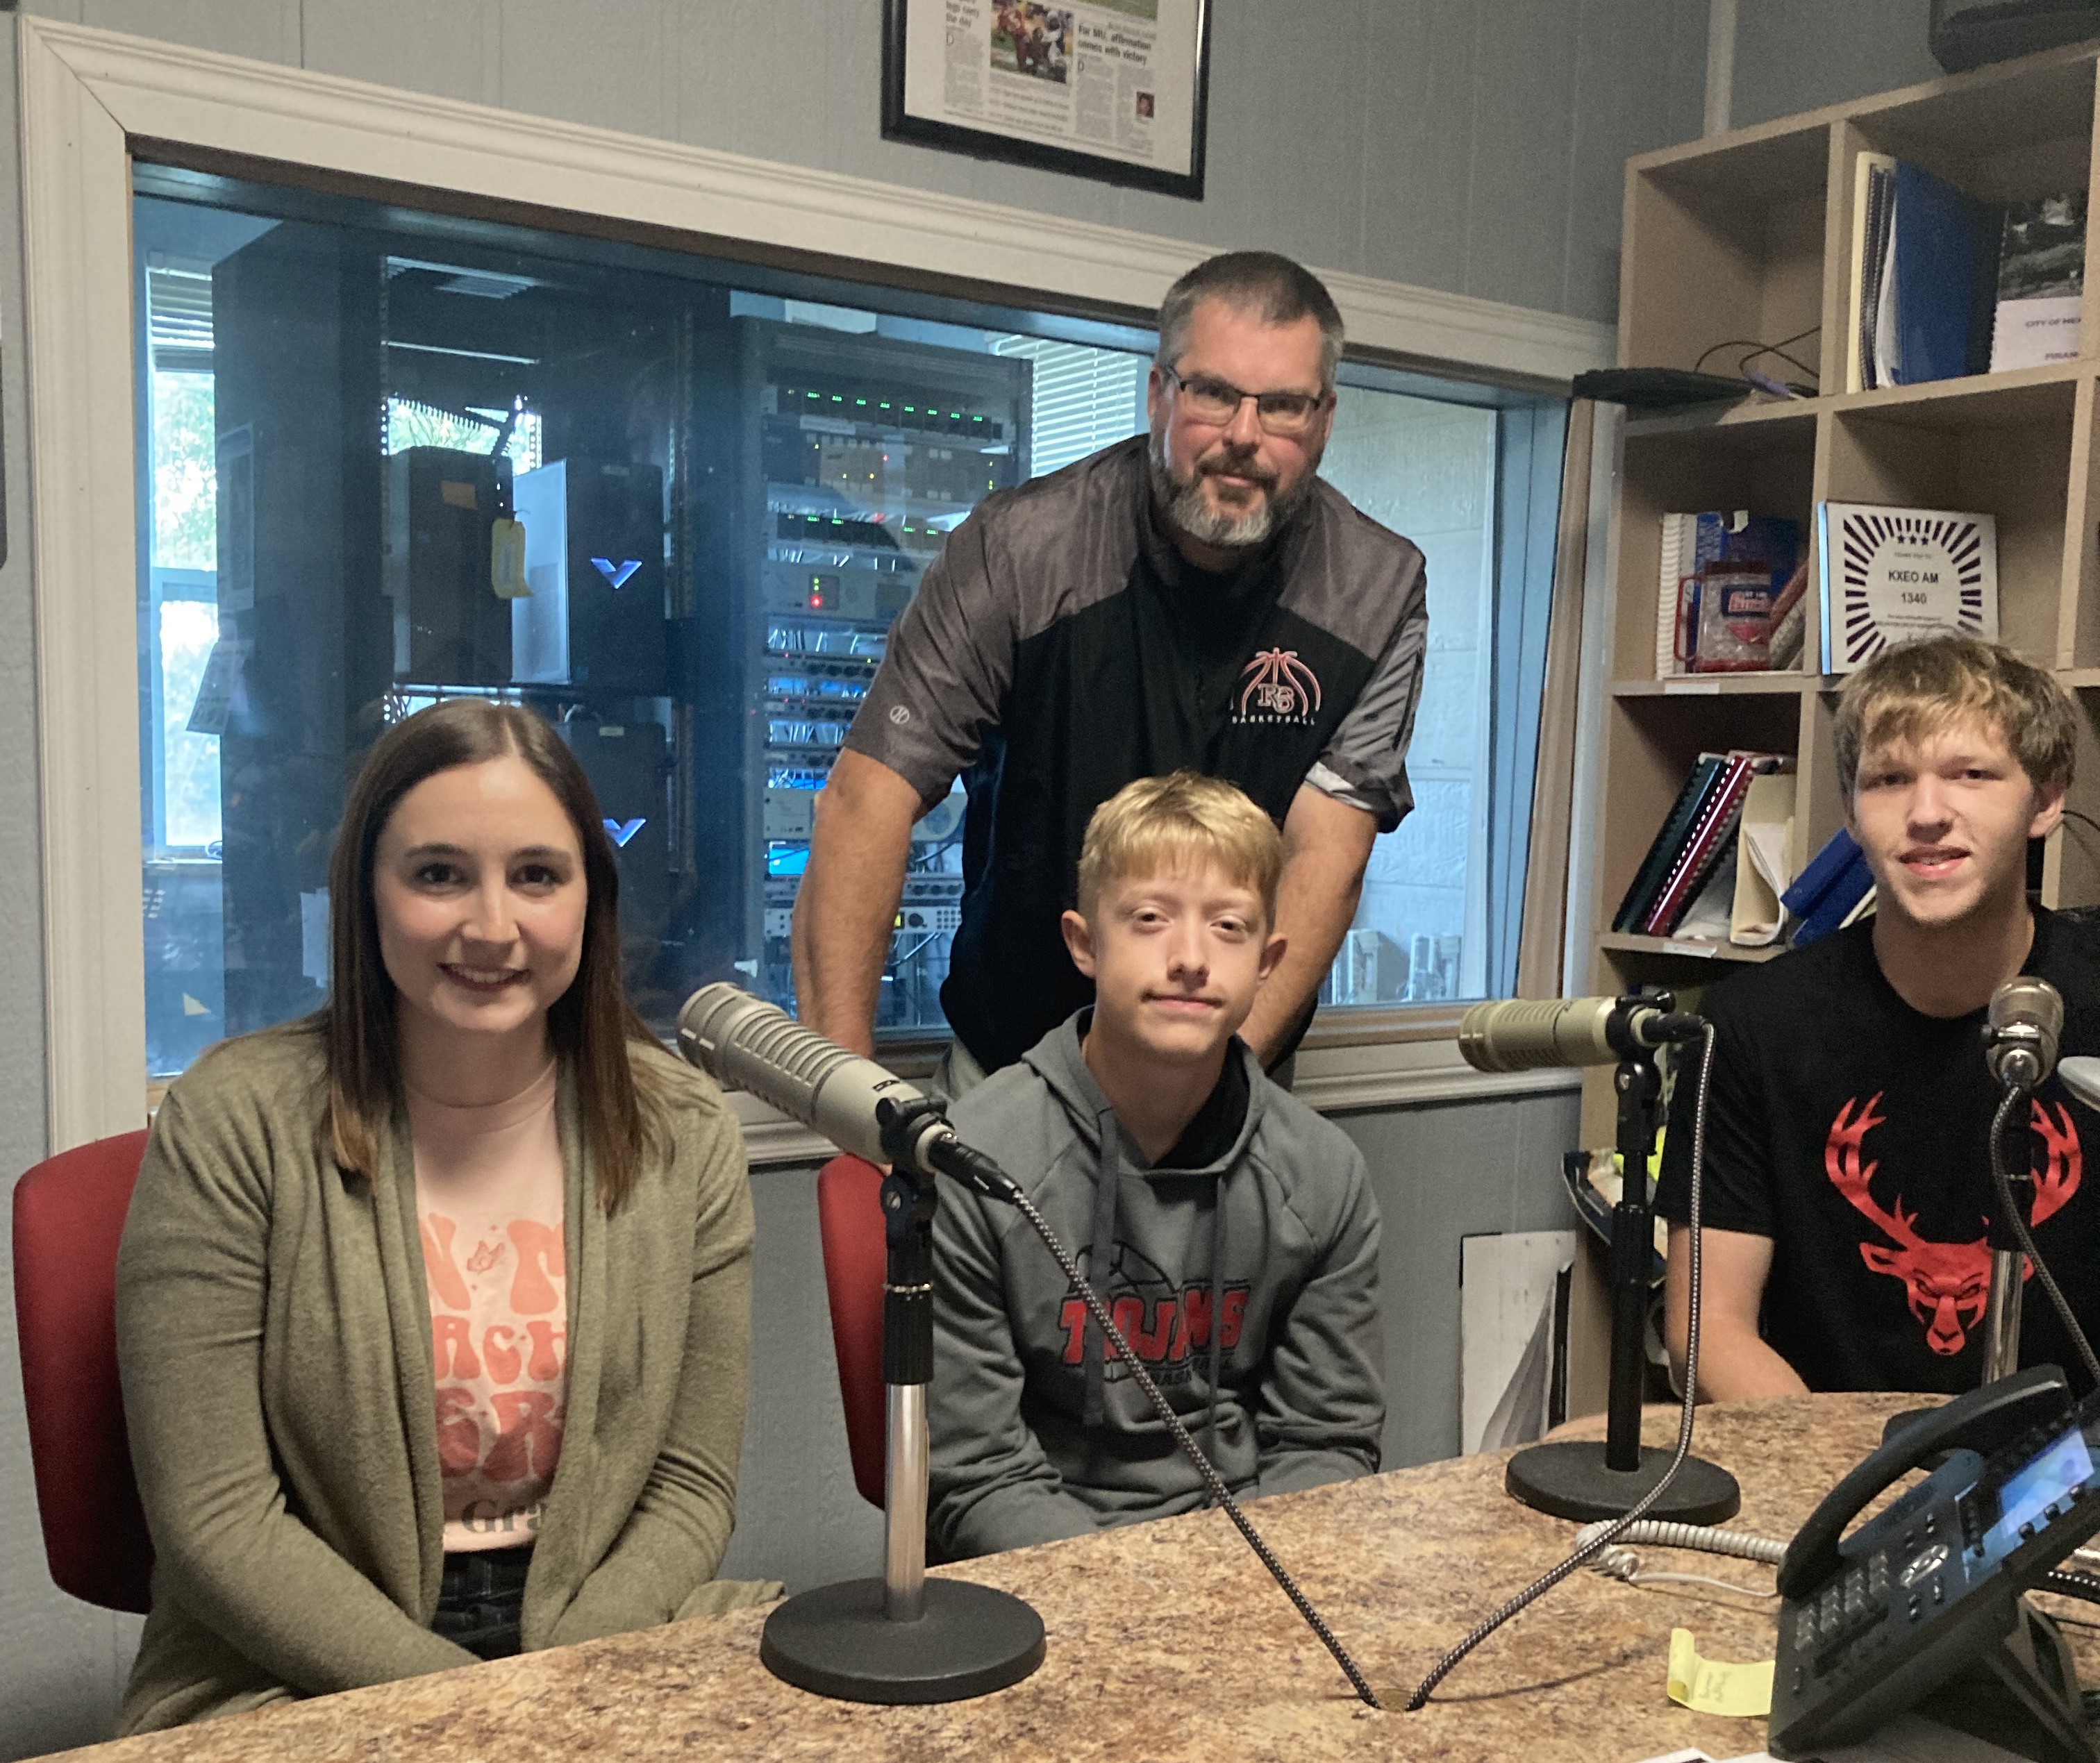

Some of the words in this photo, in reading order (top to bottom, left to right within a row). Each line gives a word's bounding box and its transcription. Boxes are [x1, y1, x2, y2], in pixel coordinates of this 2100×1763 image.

[1105, 46, 1120, 58] with
[1123, 50, 1147, 66] victory
[1889, 569, 1919, 583] KXEO
[1922, 571, 1939, 583] AM
[1901, 592, 1927, 604] 1340
